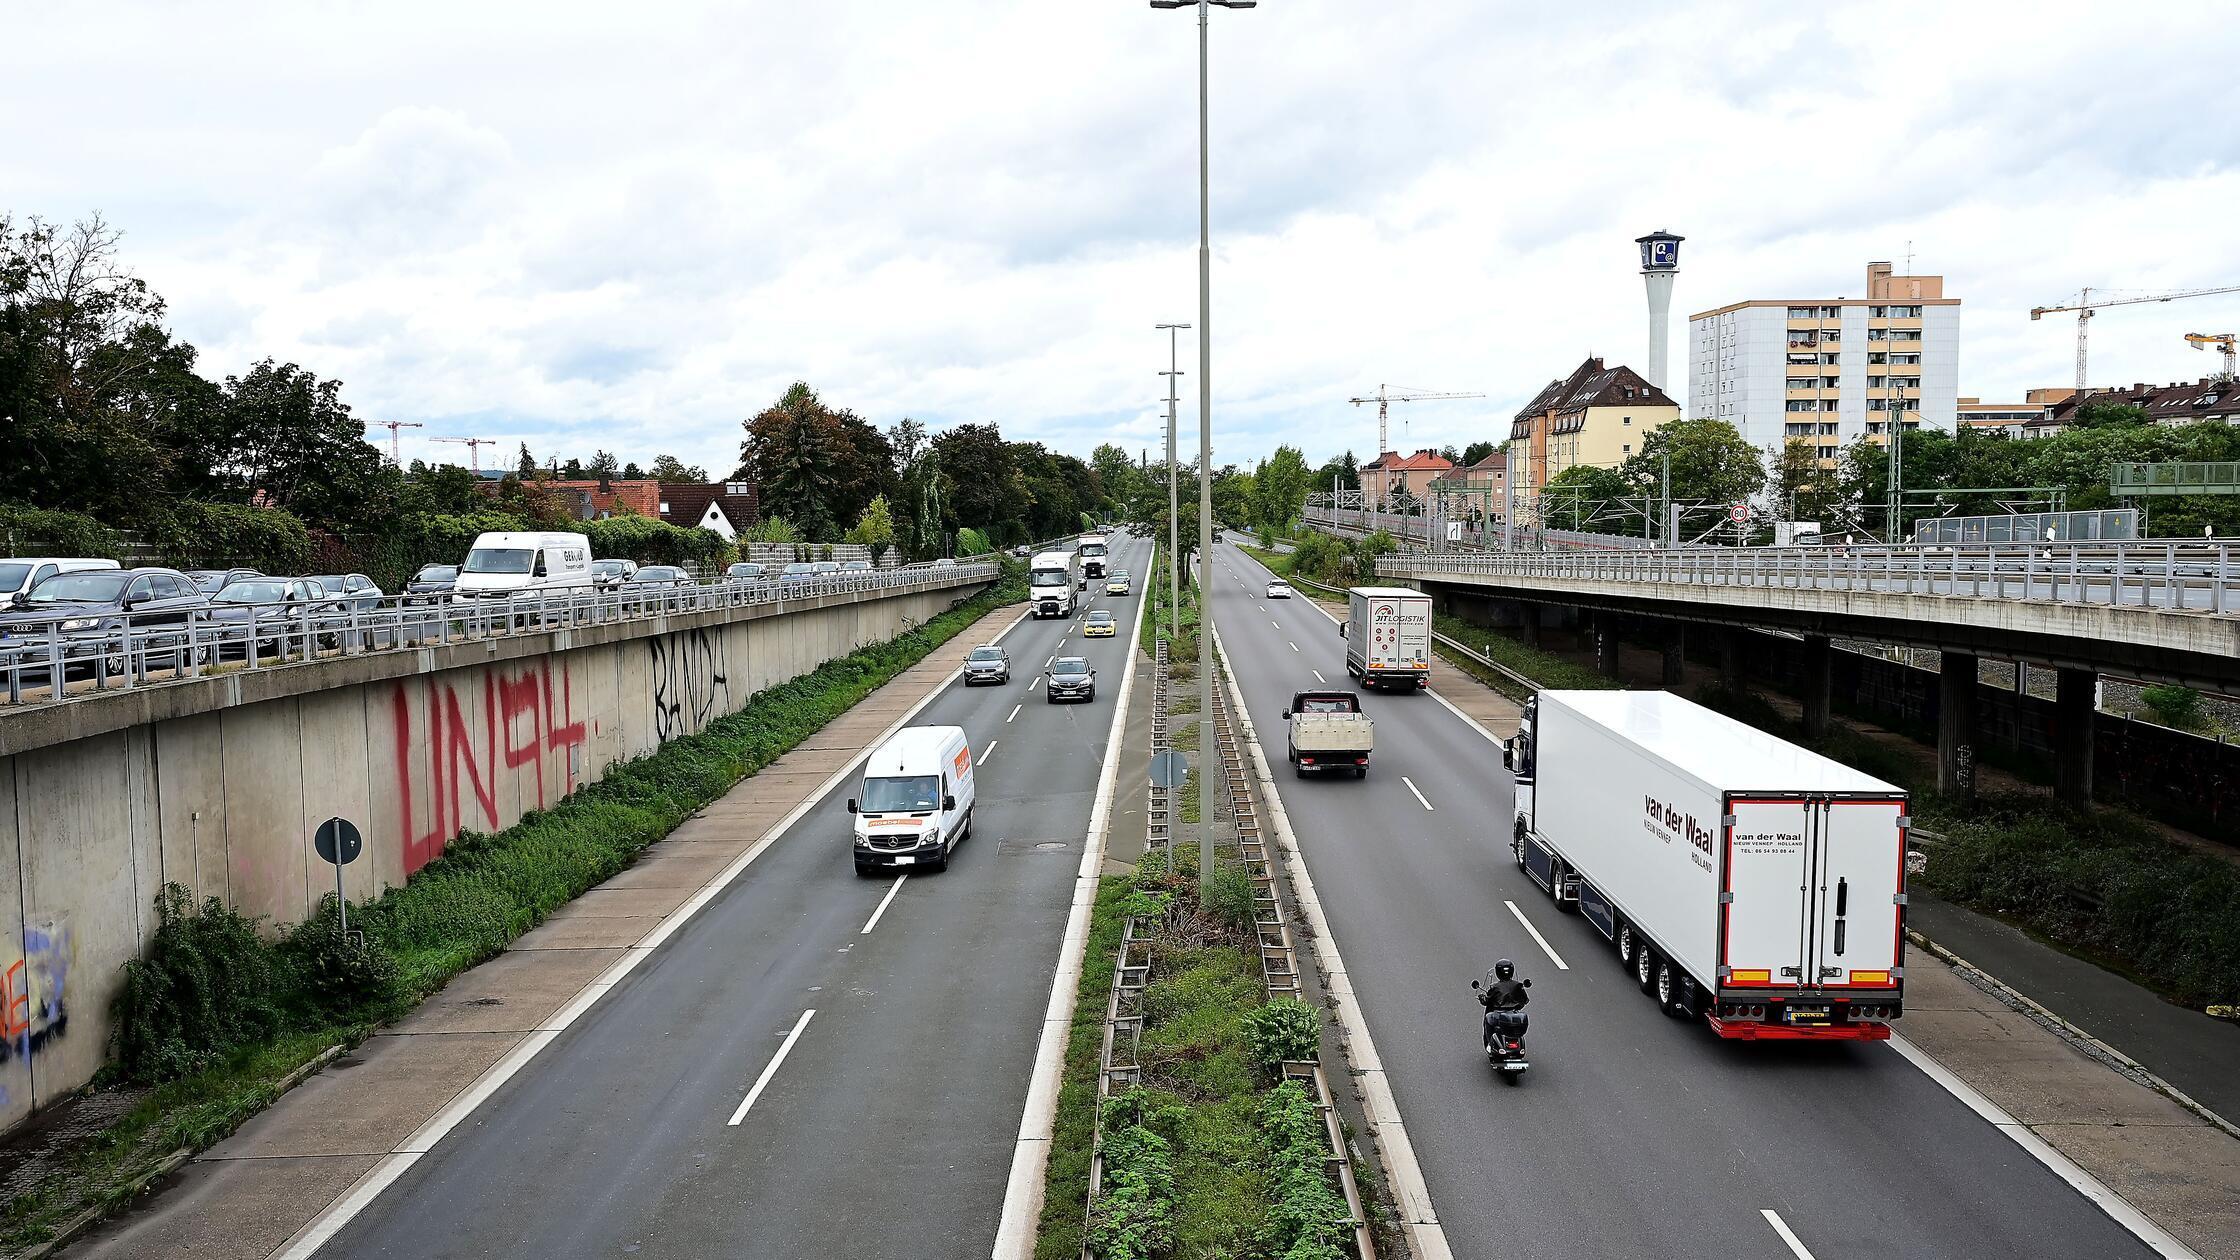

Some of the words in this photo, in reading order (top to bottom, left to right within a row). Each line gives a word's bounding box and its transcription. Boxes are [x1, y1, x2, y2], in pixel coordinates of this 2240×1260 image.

[1656, 243, 1666, 255] Q
[1734, 509, 1744, 518] 80
[1644, 794, 1662, 822] van
[1665, 802, 1683, 835] der
[1685, 812, 1713, 856] Waal
[1756, 833, 1774, 841] der
[1776, 833, 1801, 841] Waal
[1691, 851, 1713, 874] HOLLAND
